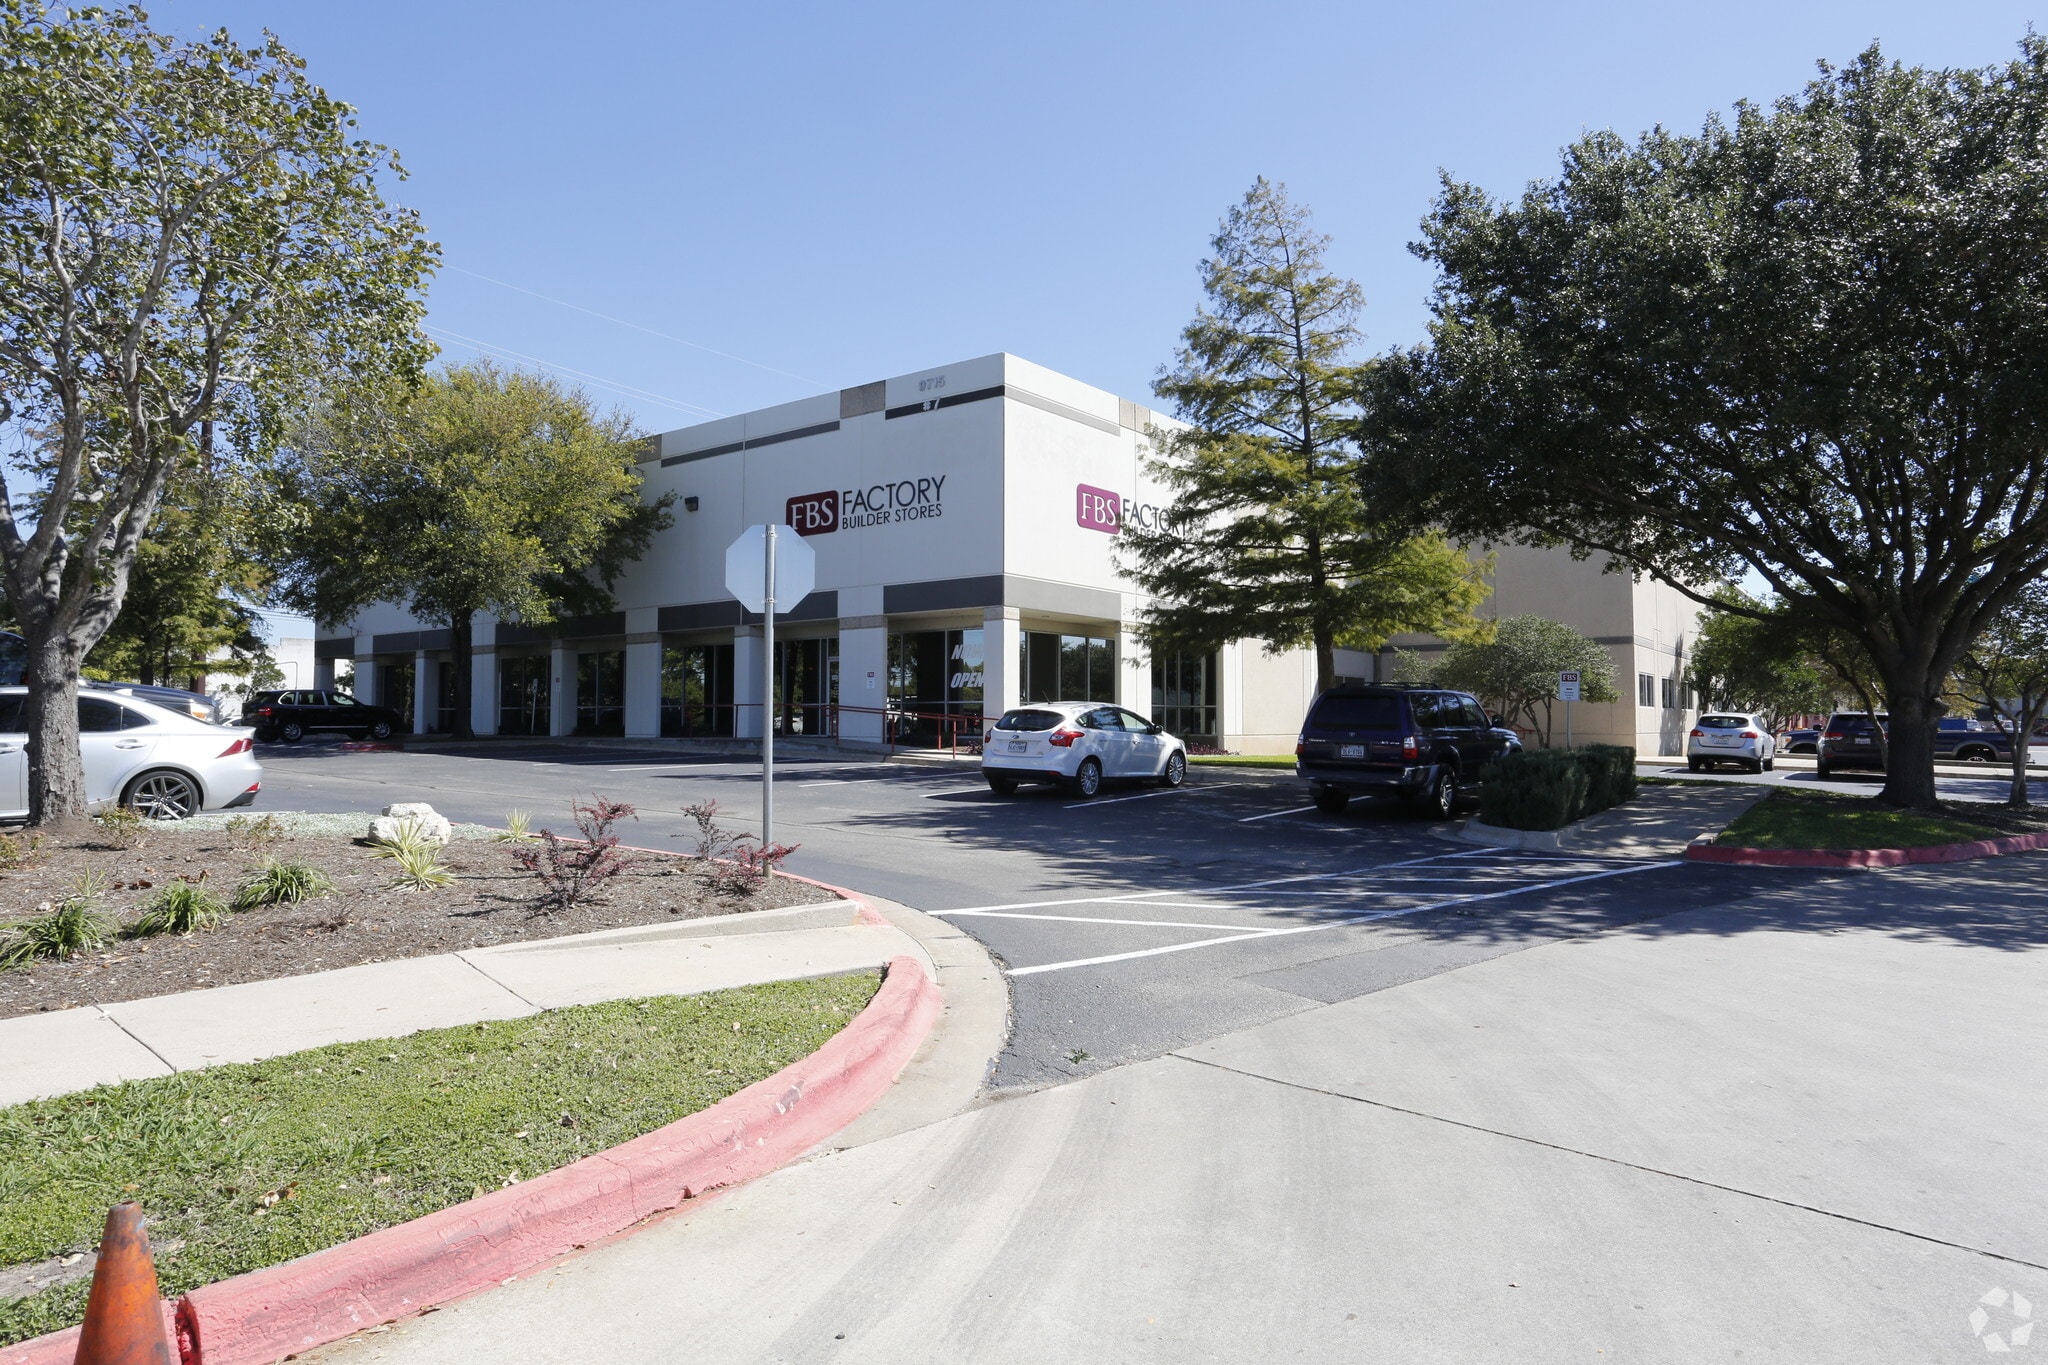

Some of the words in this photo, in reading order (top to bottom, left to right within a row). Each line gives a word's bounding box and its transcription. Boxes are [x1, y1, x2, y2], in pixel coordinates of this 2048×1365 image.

[919, 375, 946, 392] 9715
[790, 498, 834, 531] FBS
[842, 474, 946, 516] FACTORY
[1081, 492, 1116, 526] FBS
[842, 510, 891, 530] BUILDER
[895, 503, 943, 523] STORES
[950, 672, 984, 688] OPEN
